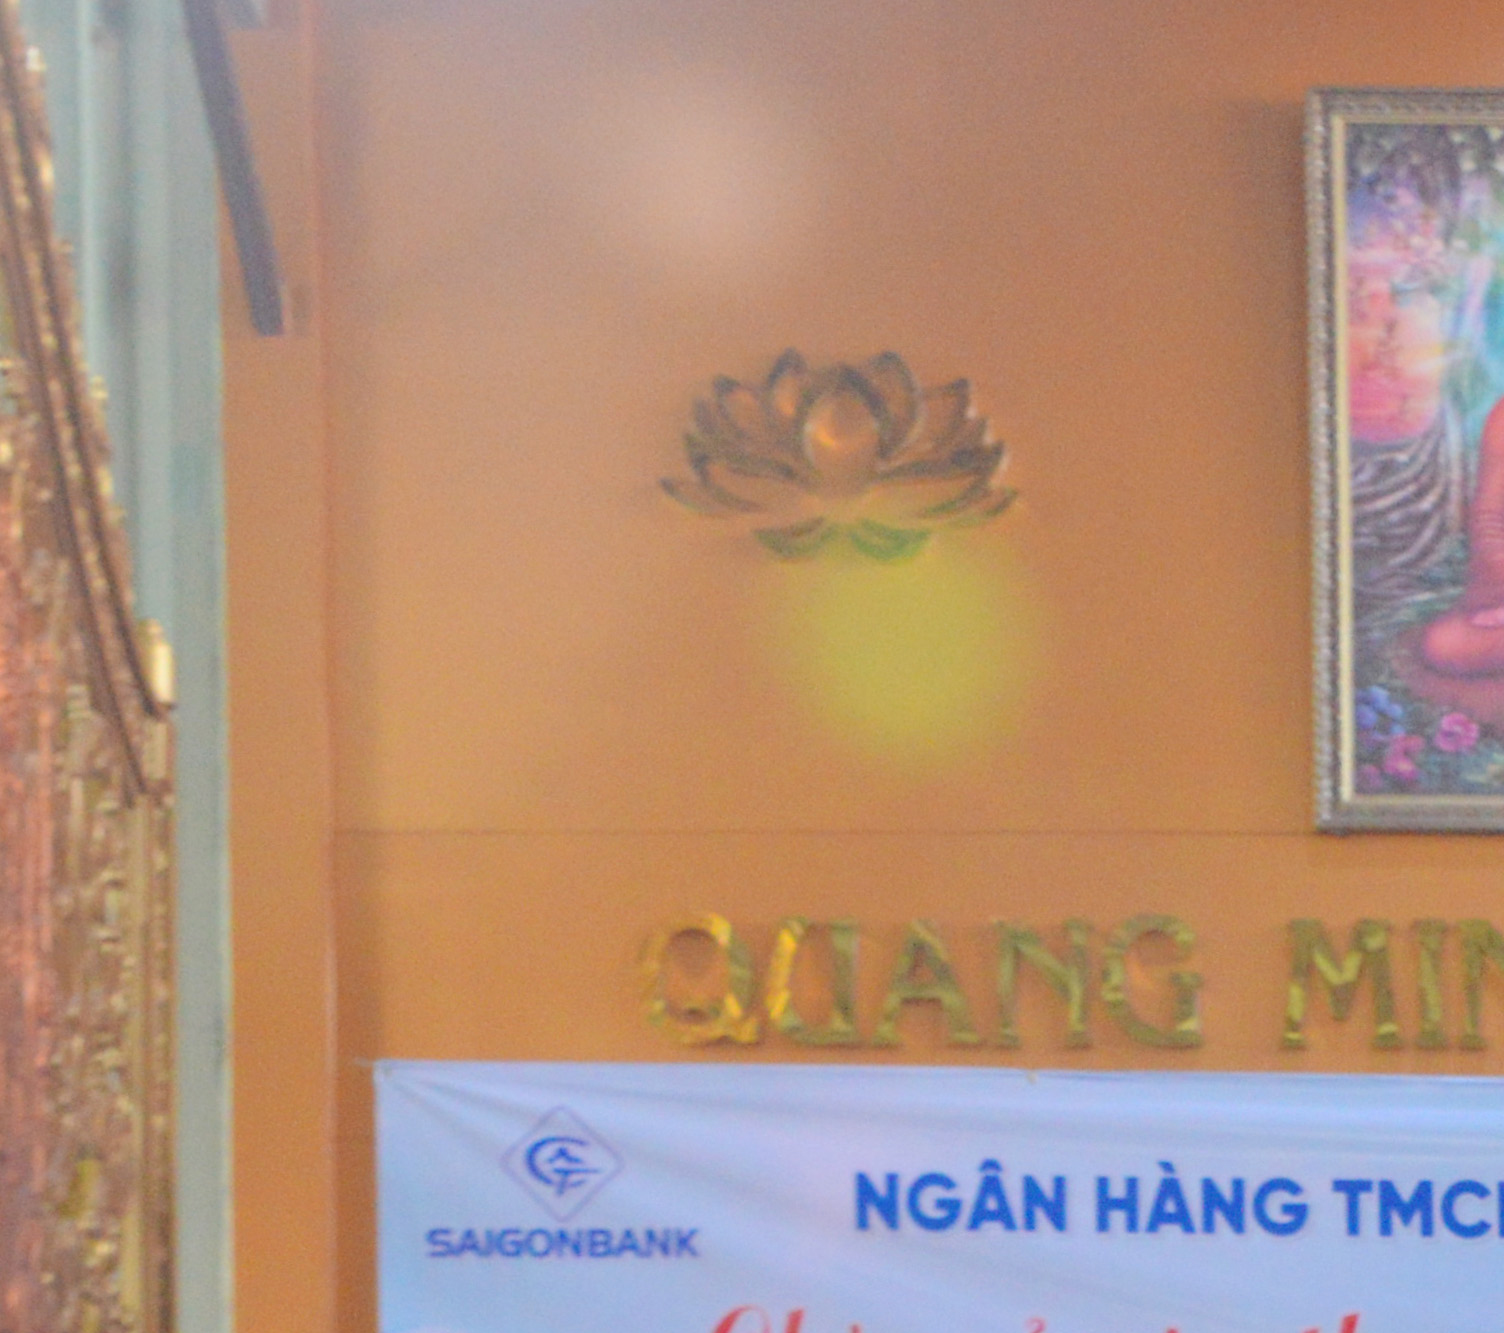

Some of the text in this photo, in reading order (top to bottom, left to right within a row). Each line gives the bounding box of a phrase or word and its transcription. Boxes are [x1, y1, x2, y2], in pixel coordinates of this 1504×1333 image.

[639, 913, 1205, 1049] QUANG
[855, 1158, 1068, 1233] NGÂN
[1095, 1160, 1310, 1237] HÀNG
[424, 1226, 698, 1260] SAIGONBANK
